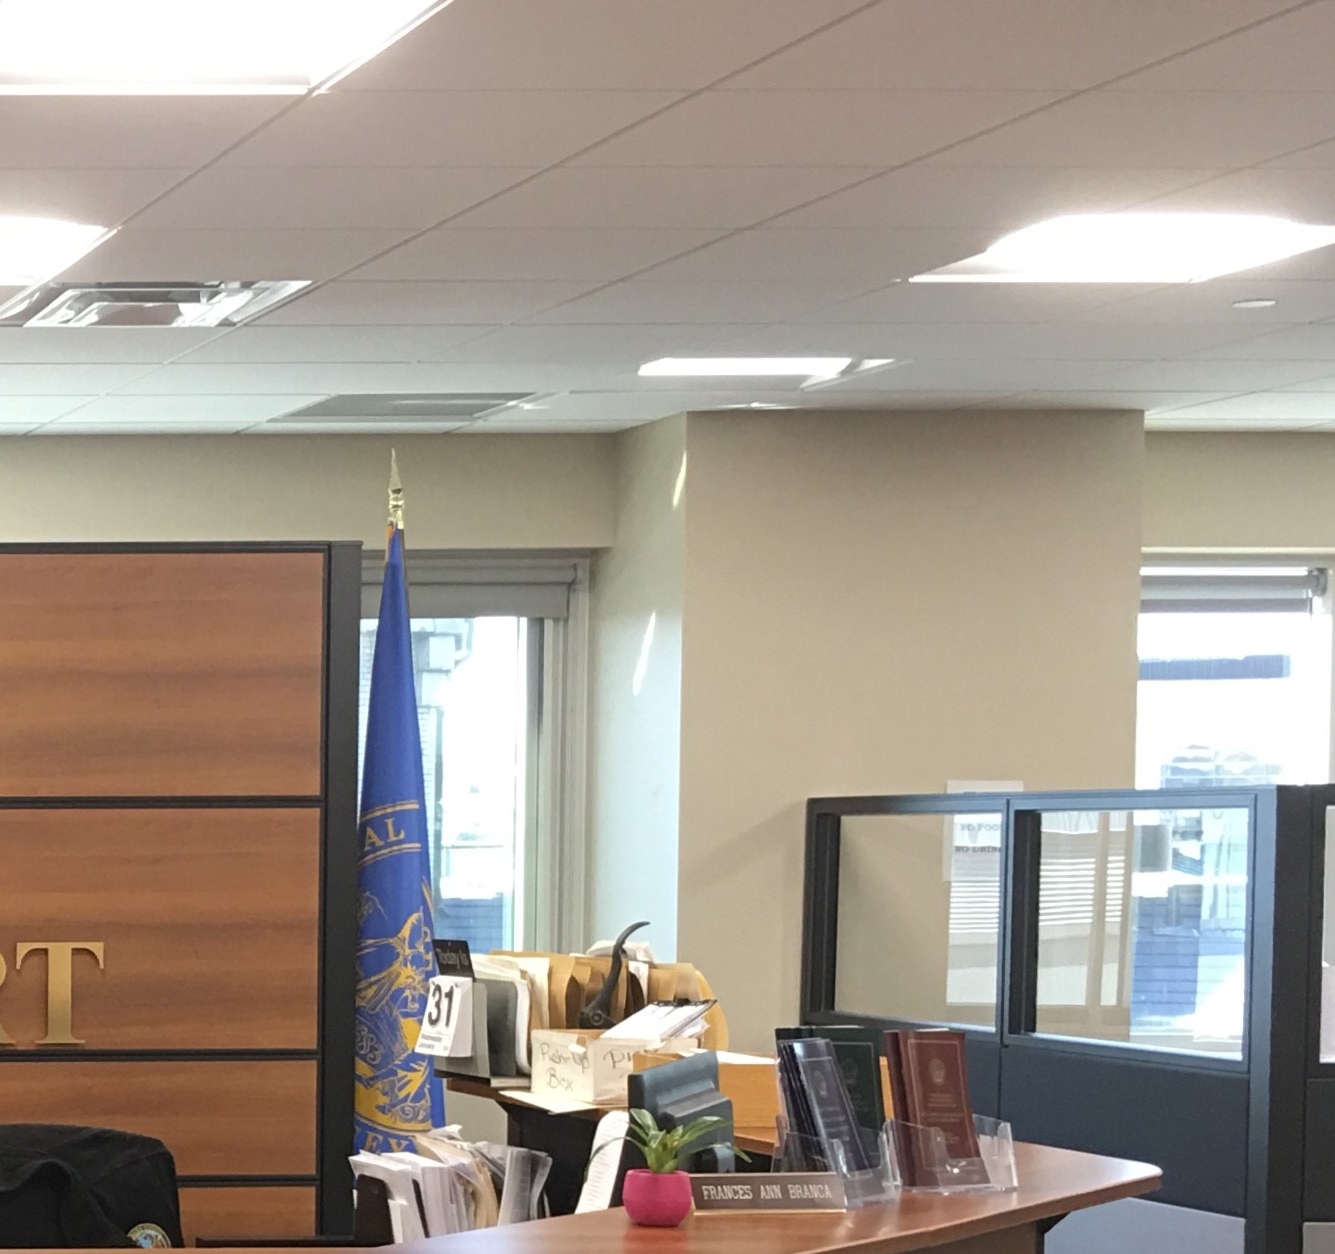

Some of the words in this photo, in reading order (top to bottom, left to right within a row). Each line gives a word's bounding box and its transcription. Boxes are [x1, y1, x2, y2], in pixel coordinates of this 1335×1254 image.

[428, 983, 454, 1028] 31
[701, 1185, 753, 1201] FRANCES
[760, 1185, 782, 1200] ANN
[787, 1184, 833, 1200] BRANCA
